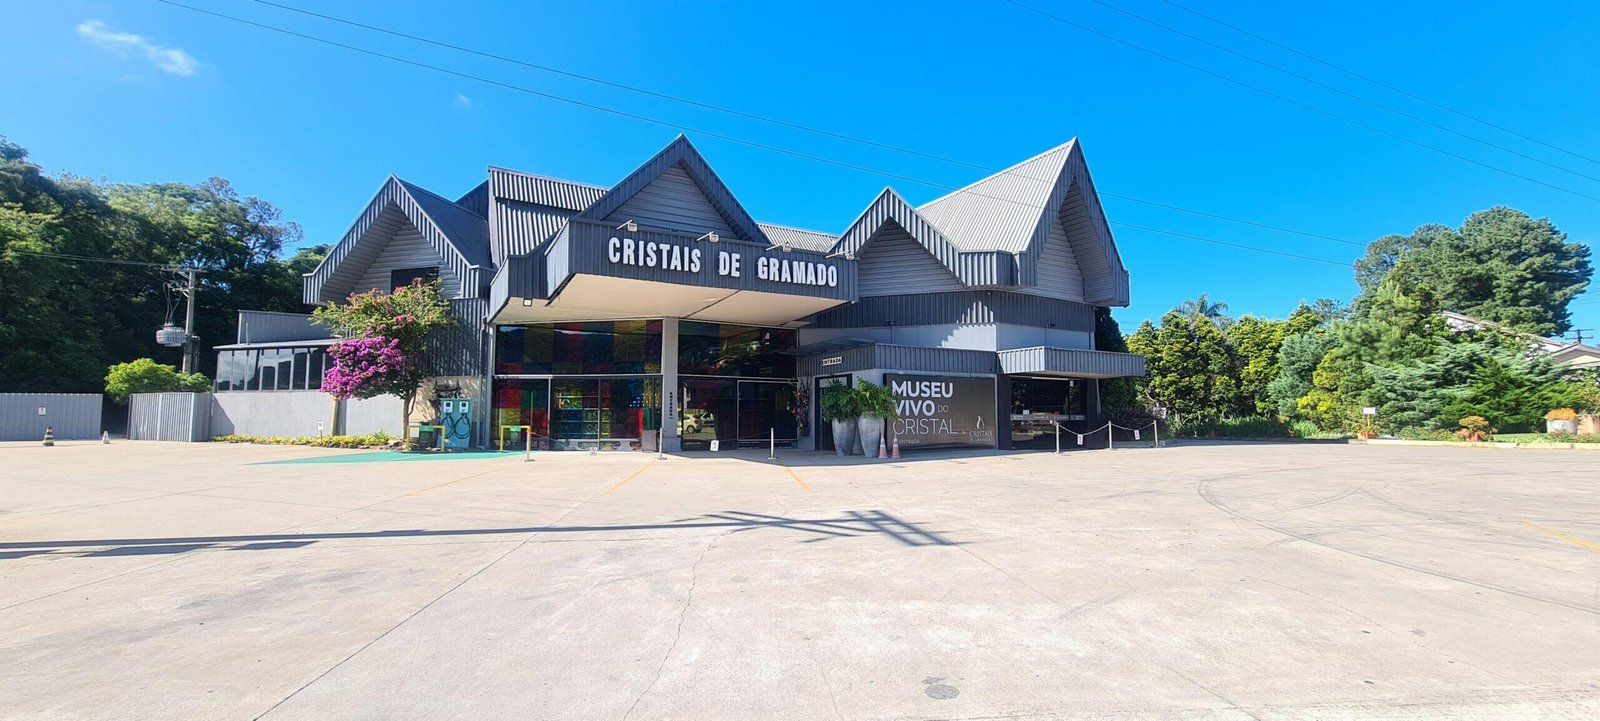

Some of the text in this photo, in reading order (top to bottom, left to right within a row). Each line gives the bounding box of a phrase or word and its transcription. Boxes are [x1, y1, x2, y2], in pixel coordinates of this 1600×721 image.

[608, 237, 838, 288] CRISTAIS DE GRAMADO
[892, 380, 953, 398] MUSEU
[892, 399, 949, 417] VIVO DO
[892, 418, 958, 435] CRISTAL
